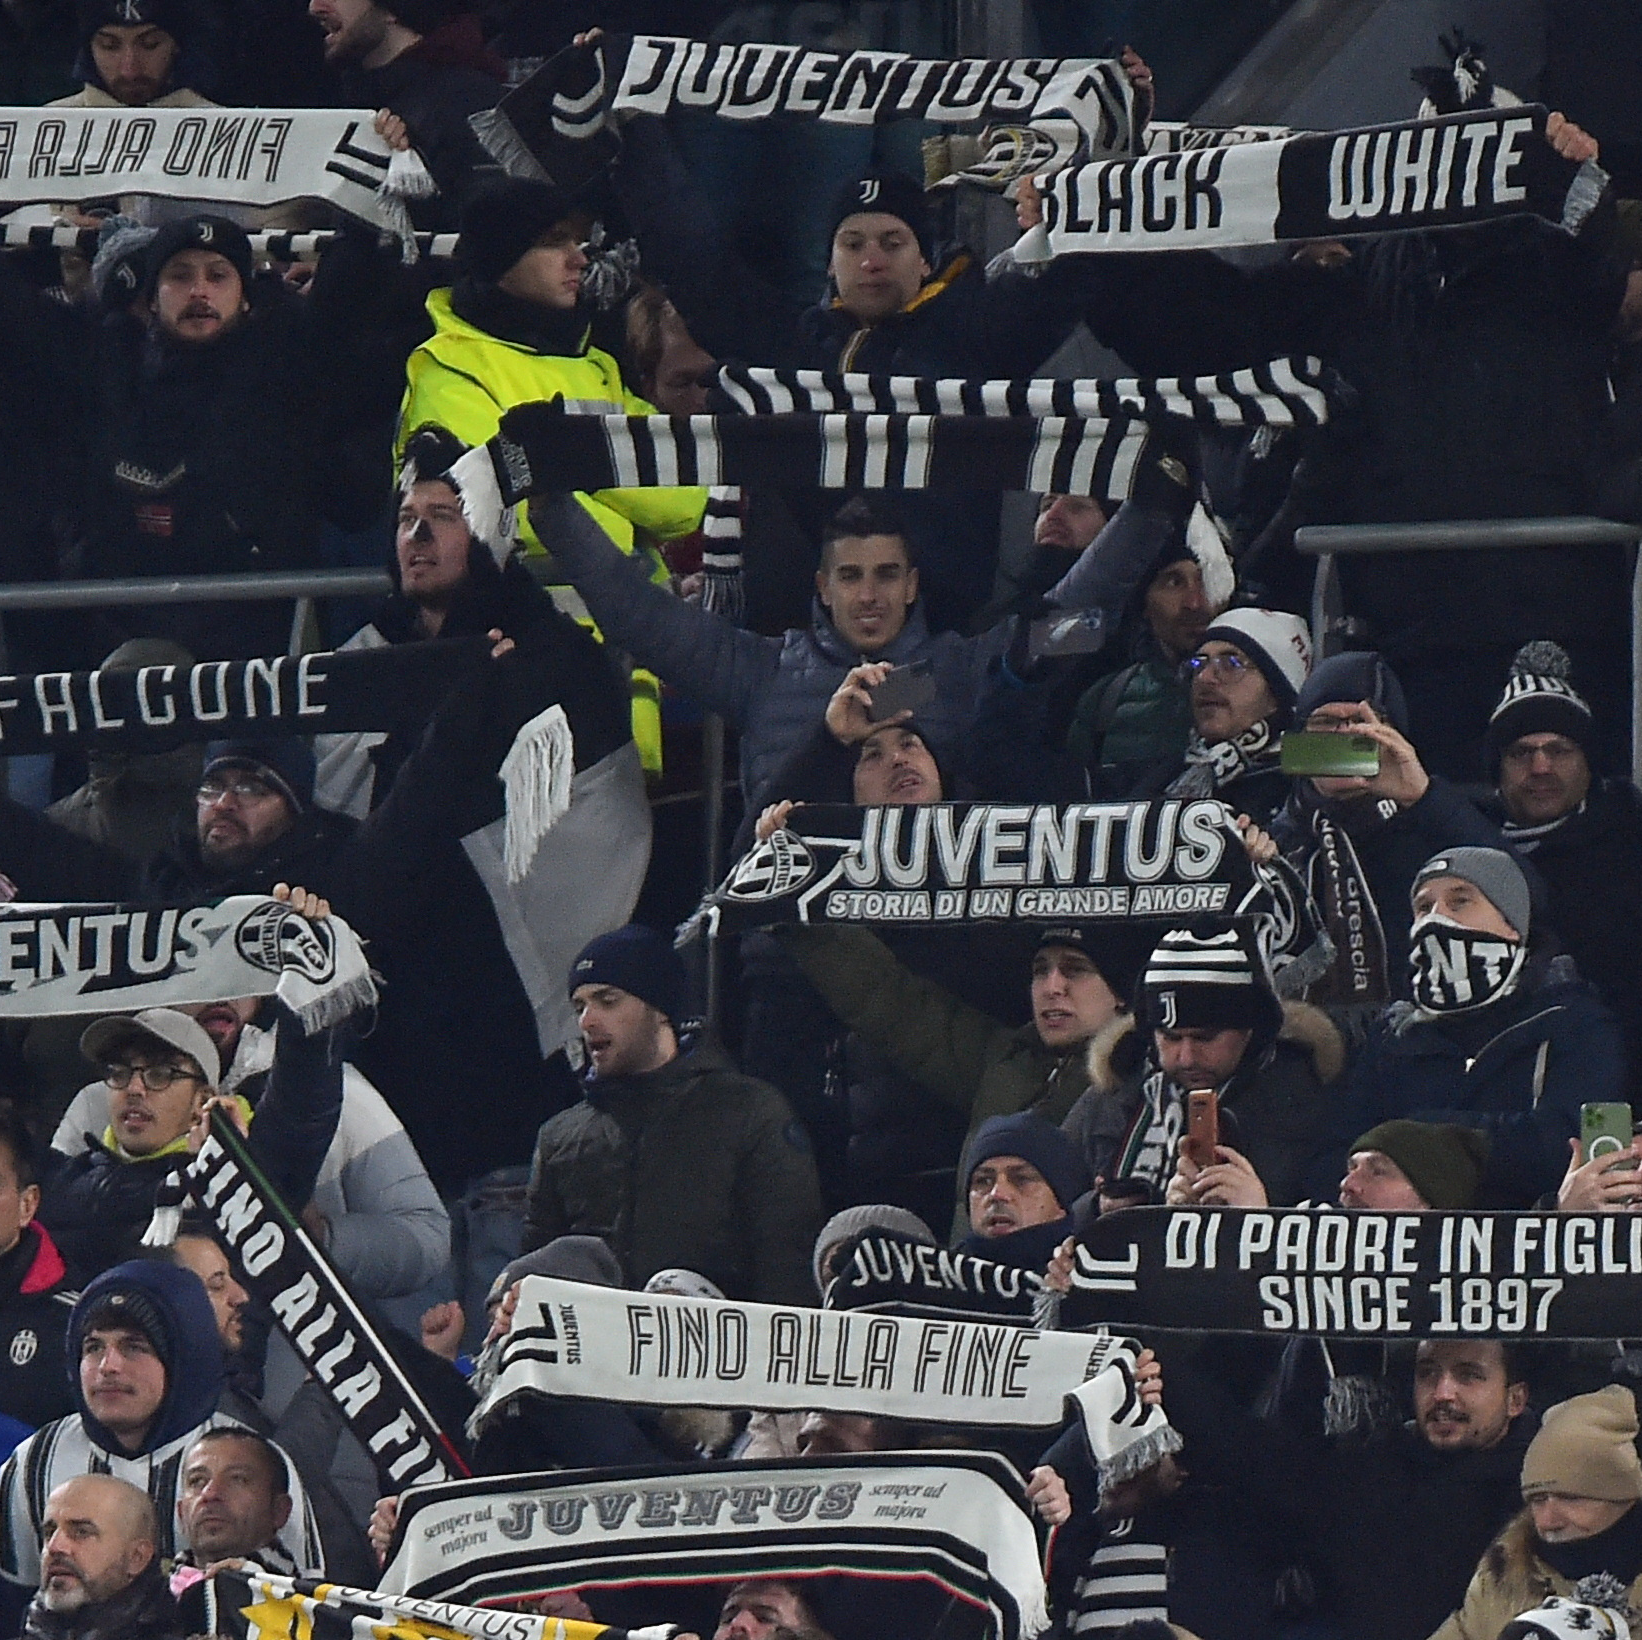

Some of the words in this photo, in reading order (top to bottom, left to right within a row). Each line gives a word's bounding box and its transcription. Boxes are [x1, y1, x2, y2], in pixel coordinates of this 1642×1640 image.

[613, 33, 1057, 124] JUVENTUS
[1040, 143, 1229, 236] BLACK
[1327, 115, 1534, 221] WHITE
[840, 798, 1229, 889] JUVENTUS
[826, 888, 931, 920] STORIA
[935, 890, 965, 919] DI
[968, 888, 1014, 918] UN
[1016, 888, 1129, 917] GRANDE
[1131, 883, 1230, 914] AMORE
[849, 1236, 1047, 1300] JUVENTUS
[1163, 1210, 1221, 1271] DI
[1236, 1212, 1423, 1275] PADRE
[1438, 1214, 1496, 1273] IN
[186, 1130, 286, 1278] FINO
[269, 1279, 384, 1423] ALLA
[367, 1413, 456, 1490] FIN
[1256, 1274, 1413, 1333] SINCE
[1427, 1275, 1565, 1333] 1897
[627, 1303, 748, 1381] FINO
[765, 1310, 897, 1396] ALLA
[912, 1320, 1042, 1401] FINE
[496, 1479, 863, 1542] JUVENTUS
[868, 1483, 921, 1501] semper
[873, 1500, 928, 1520] majora
[423, 1506, 471, 1543] semper
[439, 1527, 490, 1557] majora
